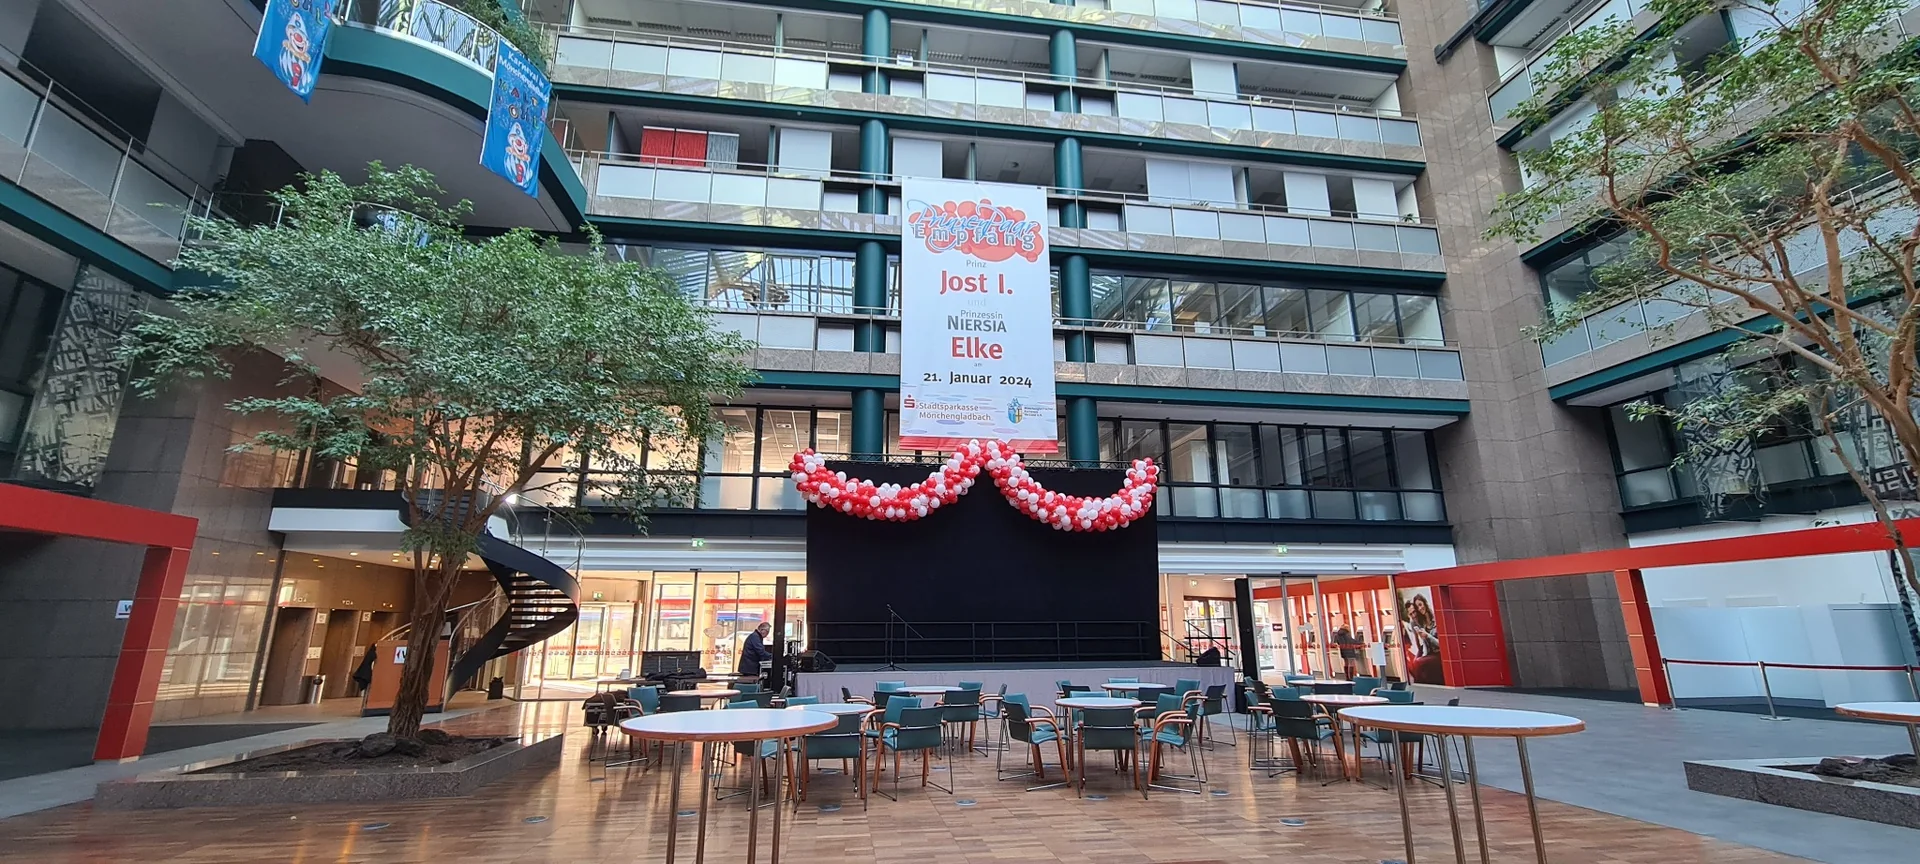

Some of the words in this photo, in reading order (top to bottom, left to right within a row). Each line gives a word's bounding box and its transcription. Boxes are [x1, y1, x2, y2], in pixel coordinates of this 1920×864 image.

[507, 50, 539, 83] Karneval
[913, 223, 1035, 250] Empfang
[966, 260, 987, 268] Prinz
[939, 270, 988, 295] Jost
[998, 273, 1013, 295] I.
[967, 298, 986, 307] und
[960, 310, 1003, 319] Prinzessin
[947, 315, 1007, 333] NIERSIA
[951, 336, 1003, 360] Elke
[923, 372, 942, 382] 21.
[949, 371, 992, 385] Januar
[999, 375, 1033, 389] 2024
[919, 402, 979, 412] Stadtsparkasse
[919, 412, 991, 421] Mönchengladbach
